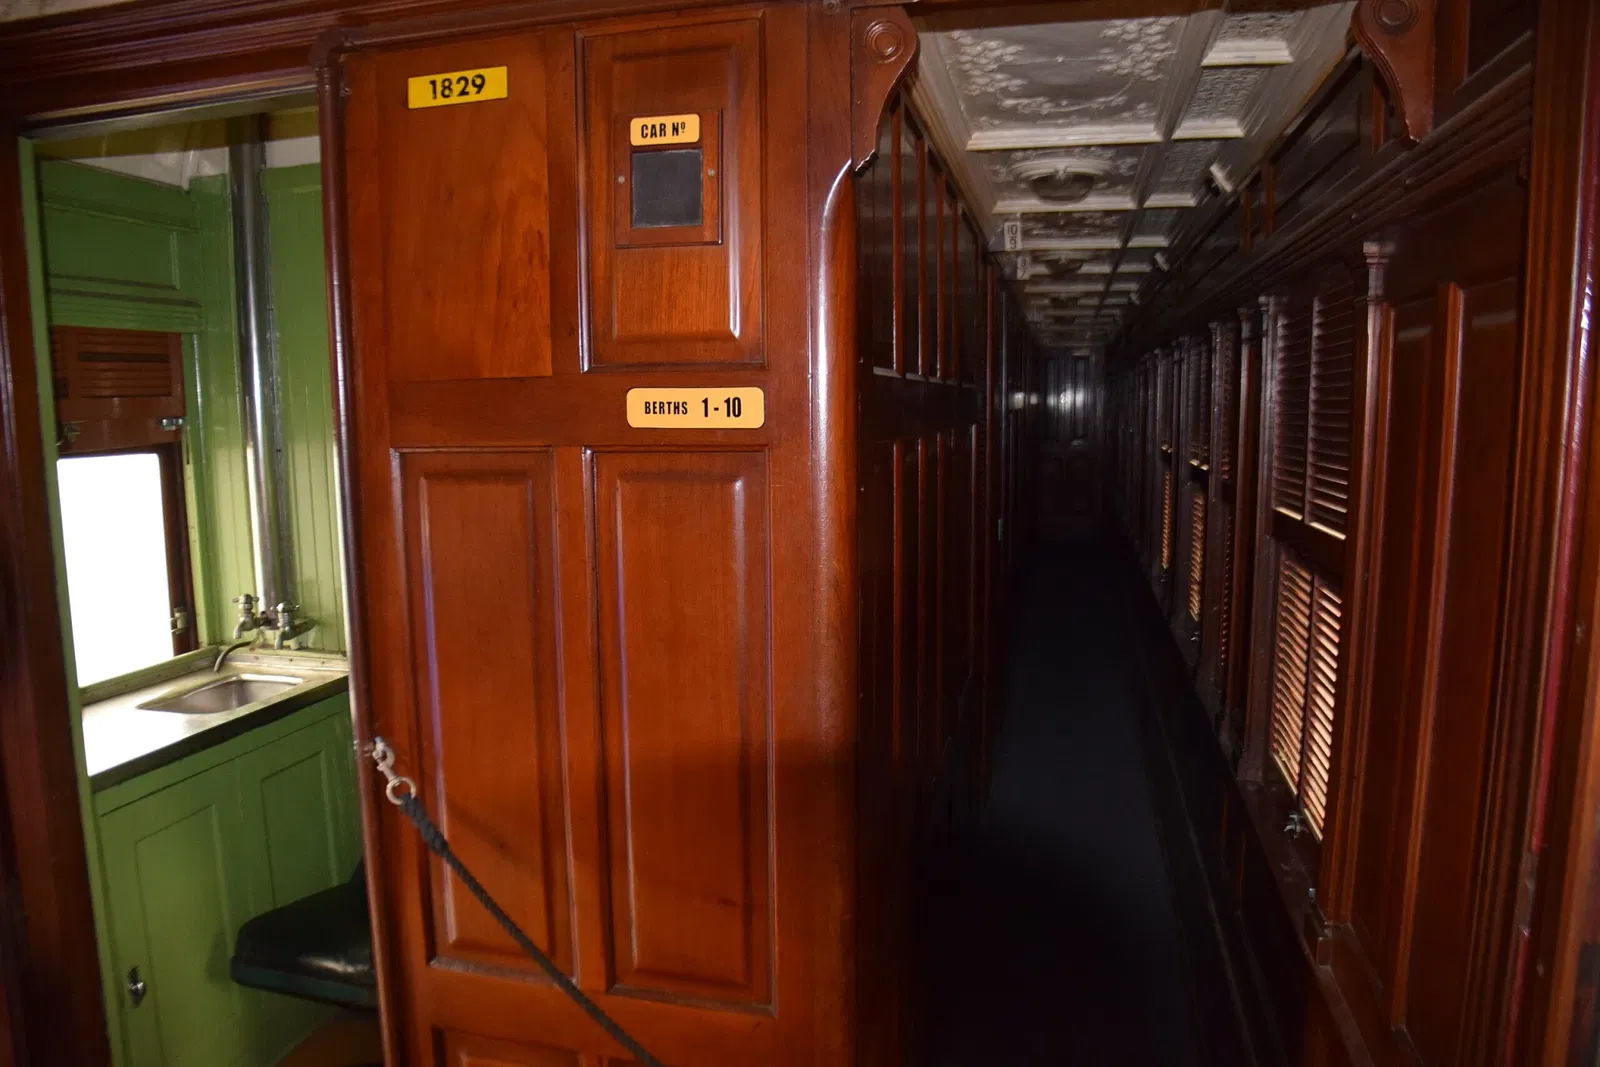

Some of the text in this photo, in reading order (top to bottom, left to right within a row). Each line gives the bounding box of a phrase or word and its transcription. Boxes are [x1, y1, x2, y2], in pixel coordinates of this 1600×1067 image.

[429, 74, 486, 100] 1829
[640, 123, 667, 139] CAR
[644, 401, 688, 415] BERTHS
